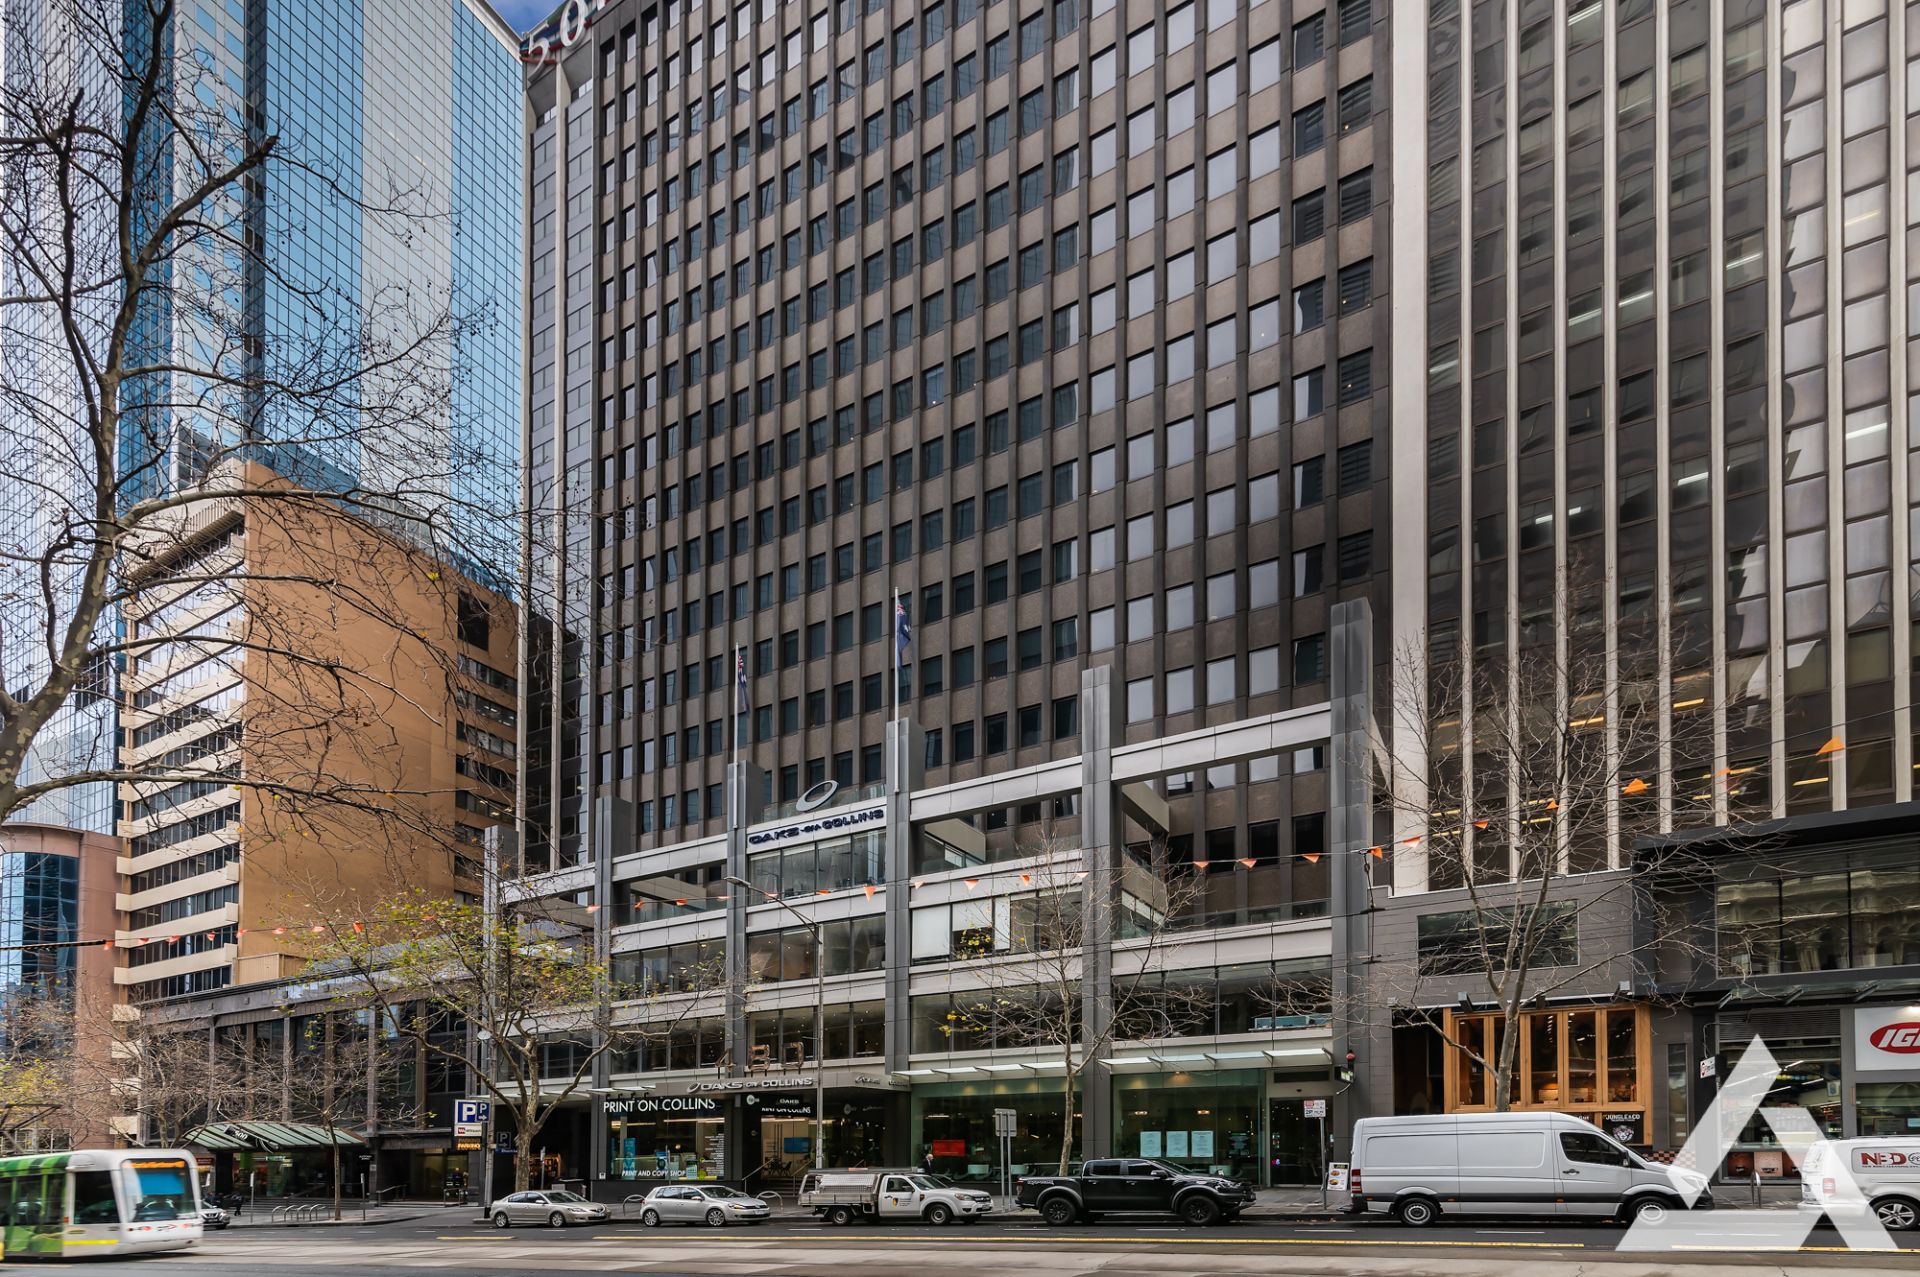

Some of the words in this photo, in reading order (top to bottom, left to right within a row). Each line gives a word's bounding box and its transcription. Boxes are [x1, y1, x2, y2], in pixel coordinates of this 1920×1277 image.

[748, 827, 800, 844] OAKS
[822, 809, 885, 829] COLLINS
[700, 1081, 743, 1091] OAKS
[761, 1077, 813, 1088] COLLINS
[462, 1103, 476, 1121] P
[480, 1103, 487, 1113] P
[603, 1100, 635, 1113] PRINT
[637, 1099, 659, 1112] ON
[661, 1097, 716, 1110] COLLINS
[234, 1130, 249, 1140] 500
